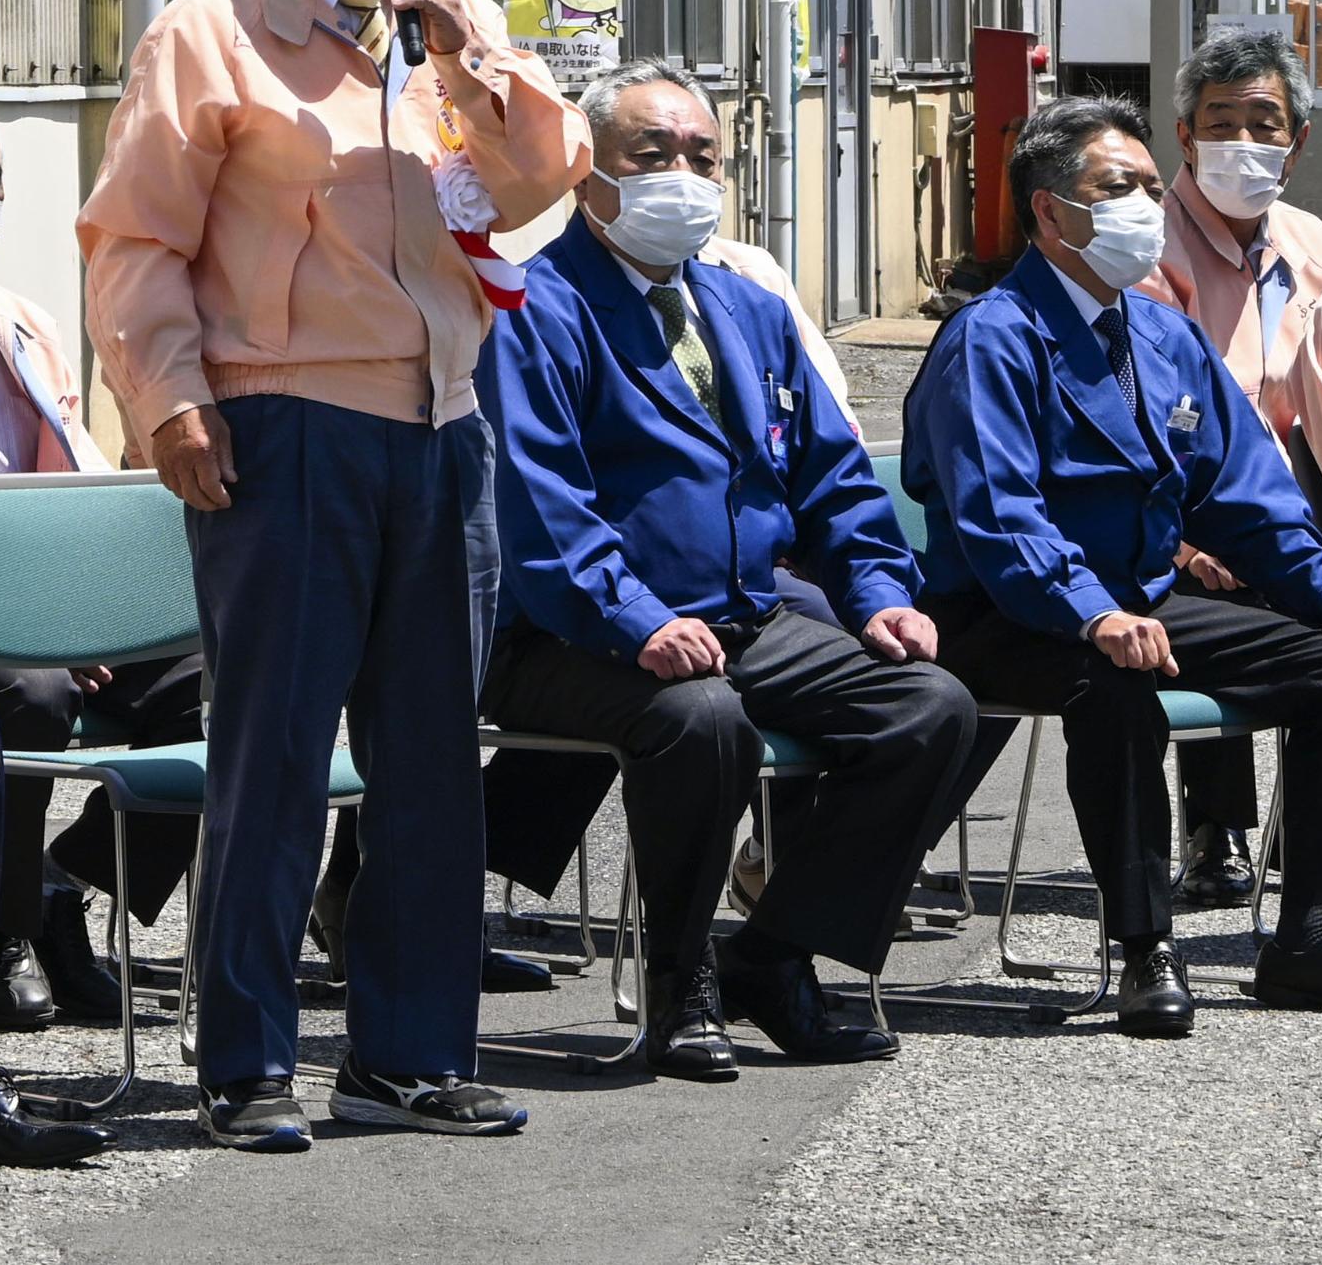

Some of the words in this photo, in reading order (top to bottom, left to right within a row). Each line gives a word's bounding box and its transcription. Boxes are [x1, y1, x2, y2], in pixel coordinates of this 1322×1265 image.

[536, 41, 602, 57] 鳥取いなば
